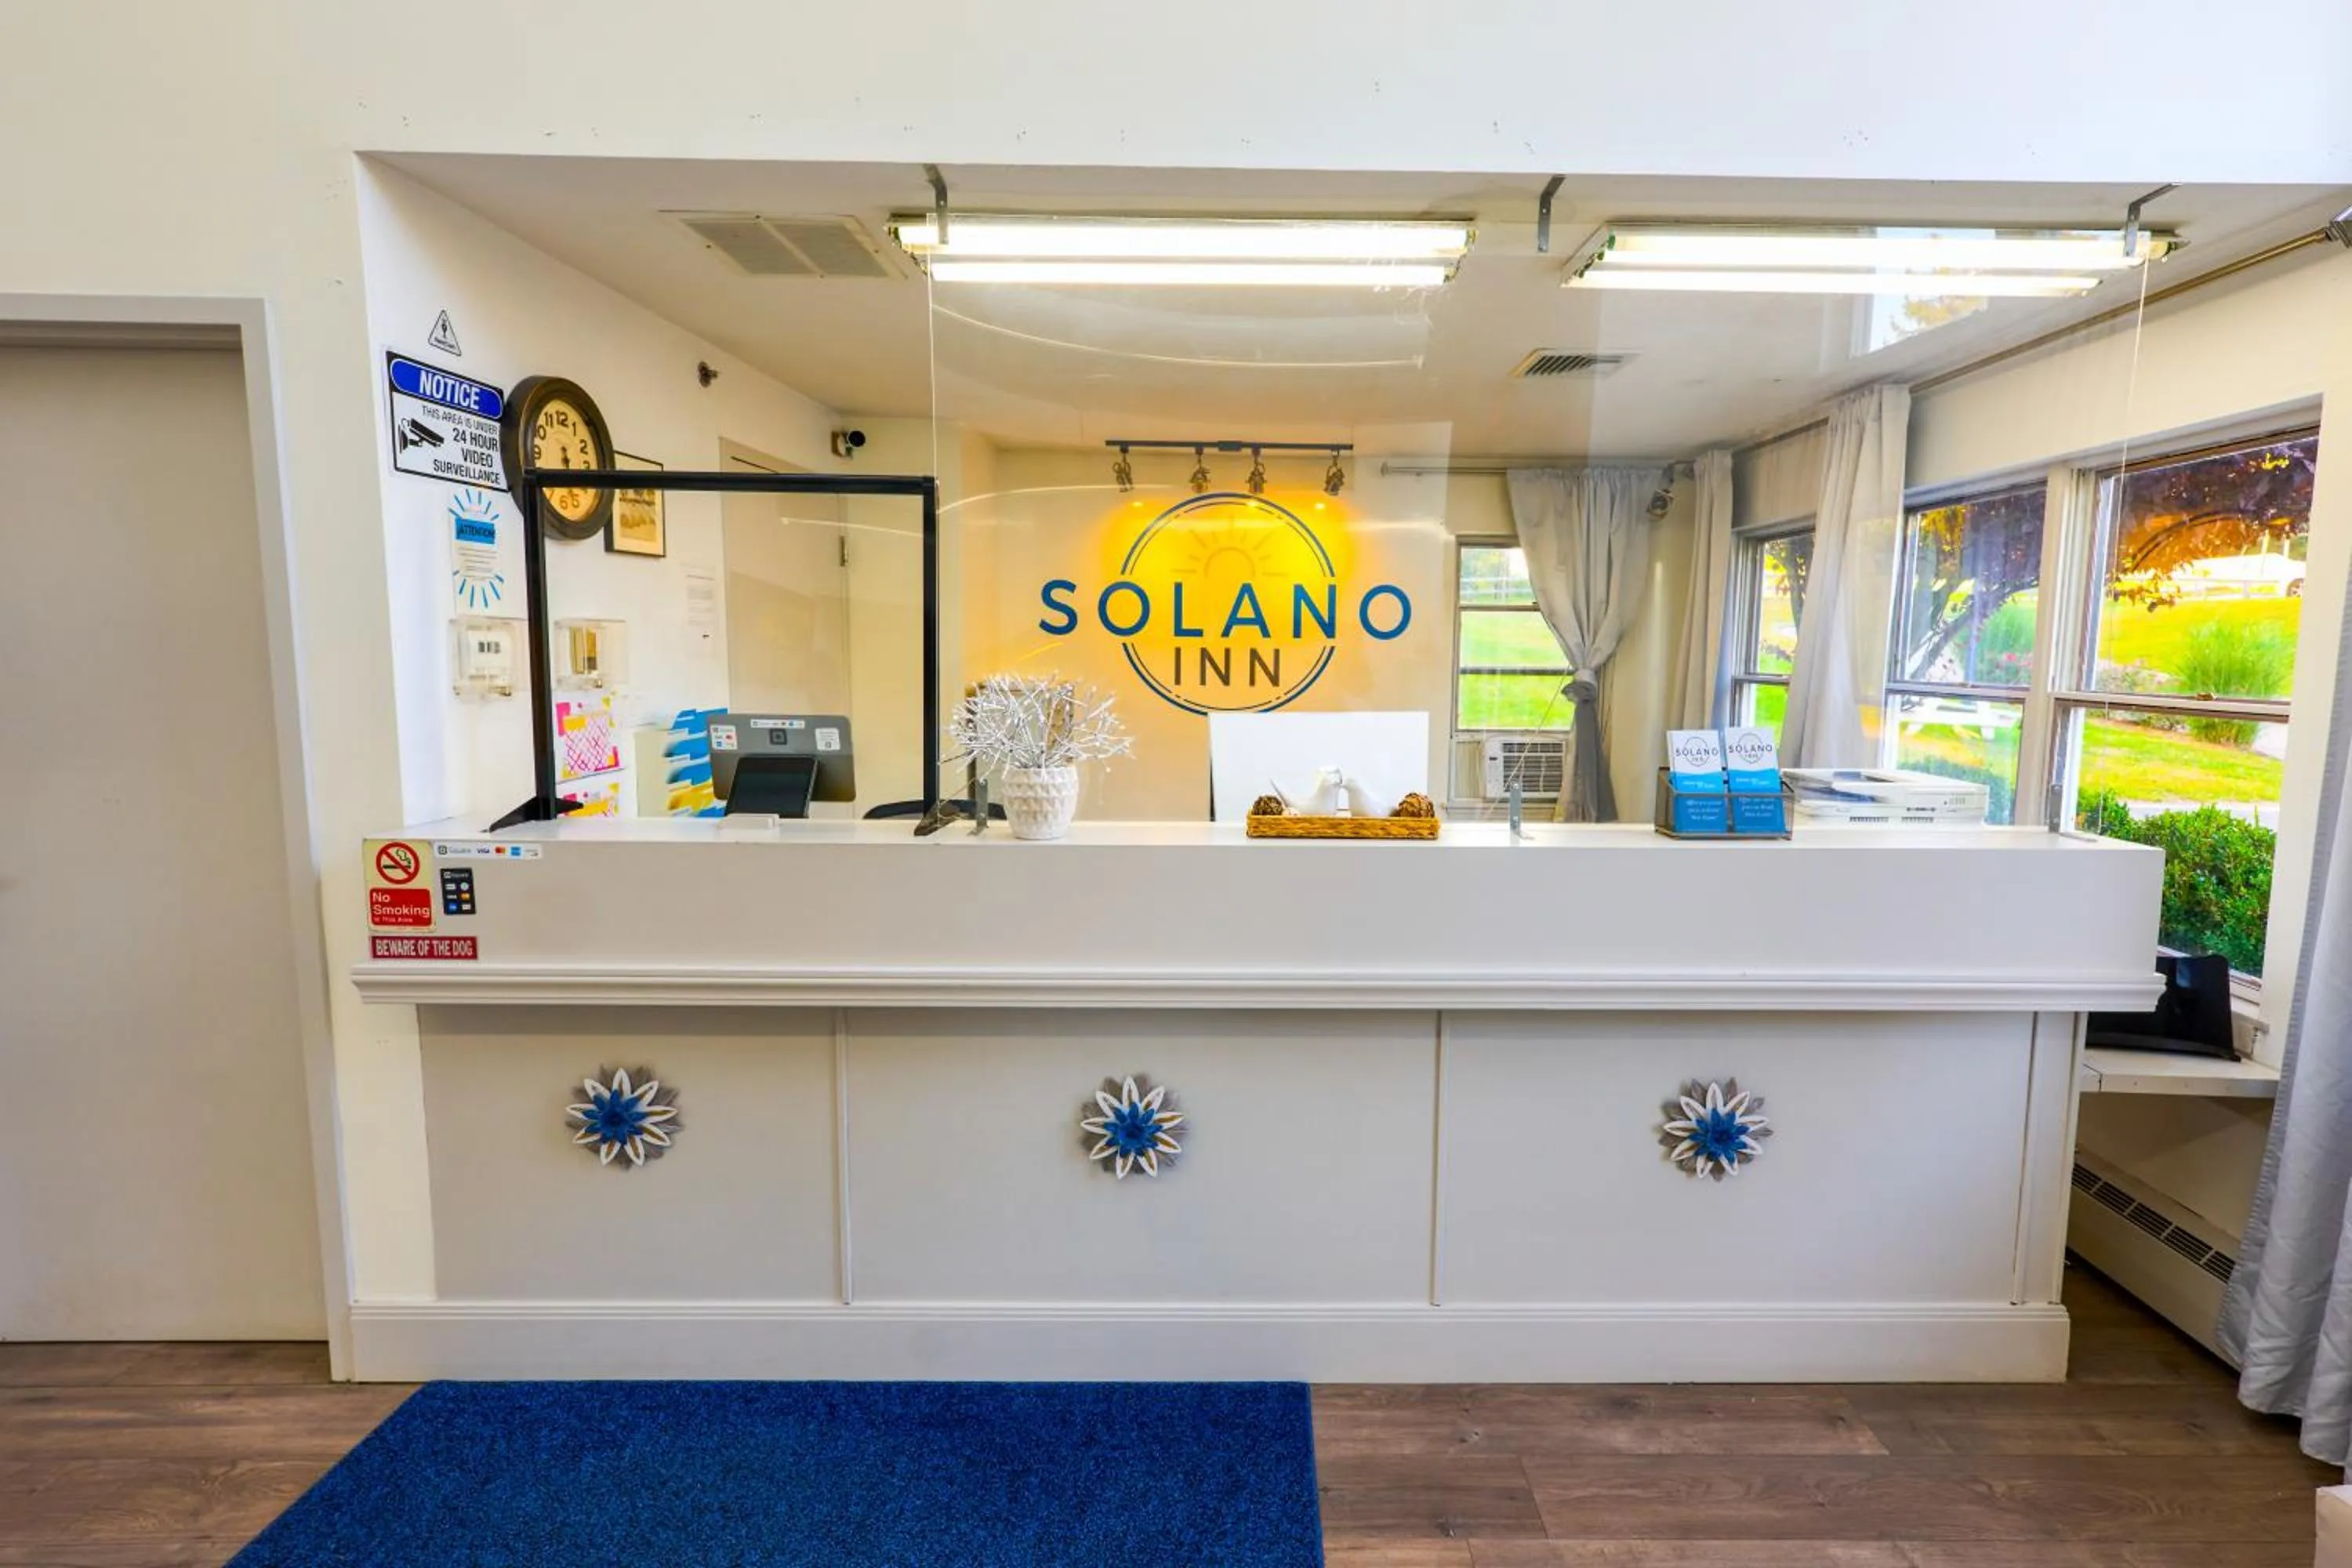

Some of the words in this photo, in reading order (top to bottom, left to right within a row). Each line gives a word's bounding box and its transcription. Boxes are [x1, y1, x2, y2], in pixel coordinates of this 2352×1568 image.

[419, 370, 481, 410] NOTICE
[423, 405, 440, 419] THIS
[442, 411, 463, 425] AREA
[465, 418, 472, 429] IS
[474, 420, 498, 434] UNDER
[544, 412, 554, 428] 11
[556, 410, 568, 427] 12
[535, 424, 546, 441] 0
[572, 422, 577, 437] 1
[452, 427, 467, 444] 24
[470, 432, 498, 452] HOUR
[579, 439, 589, 456] 2
[461, 448, 493, 468] VIDEO
[434, 459, 501, 485] SURVEILLANCE
[1039, 579, 1412, 640] SOLANO
[1174, 647, 1281, 688] INN
[1675, 747, 1719, 757] SOLANO
[1728, 744, 1773, 753] SOLANO
[372, 891, 390, 902] No
[373, 904, 430, 918] Smoking
[376, 939, 416, 956] BEWARE
[417, 939, 430, 956] OF
[432, 940, 451, 956] THE
[452, 940, 473, 956] DOG
